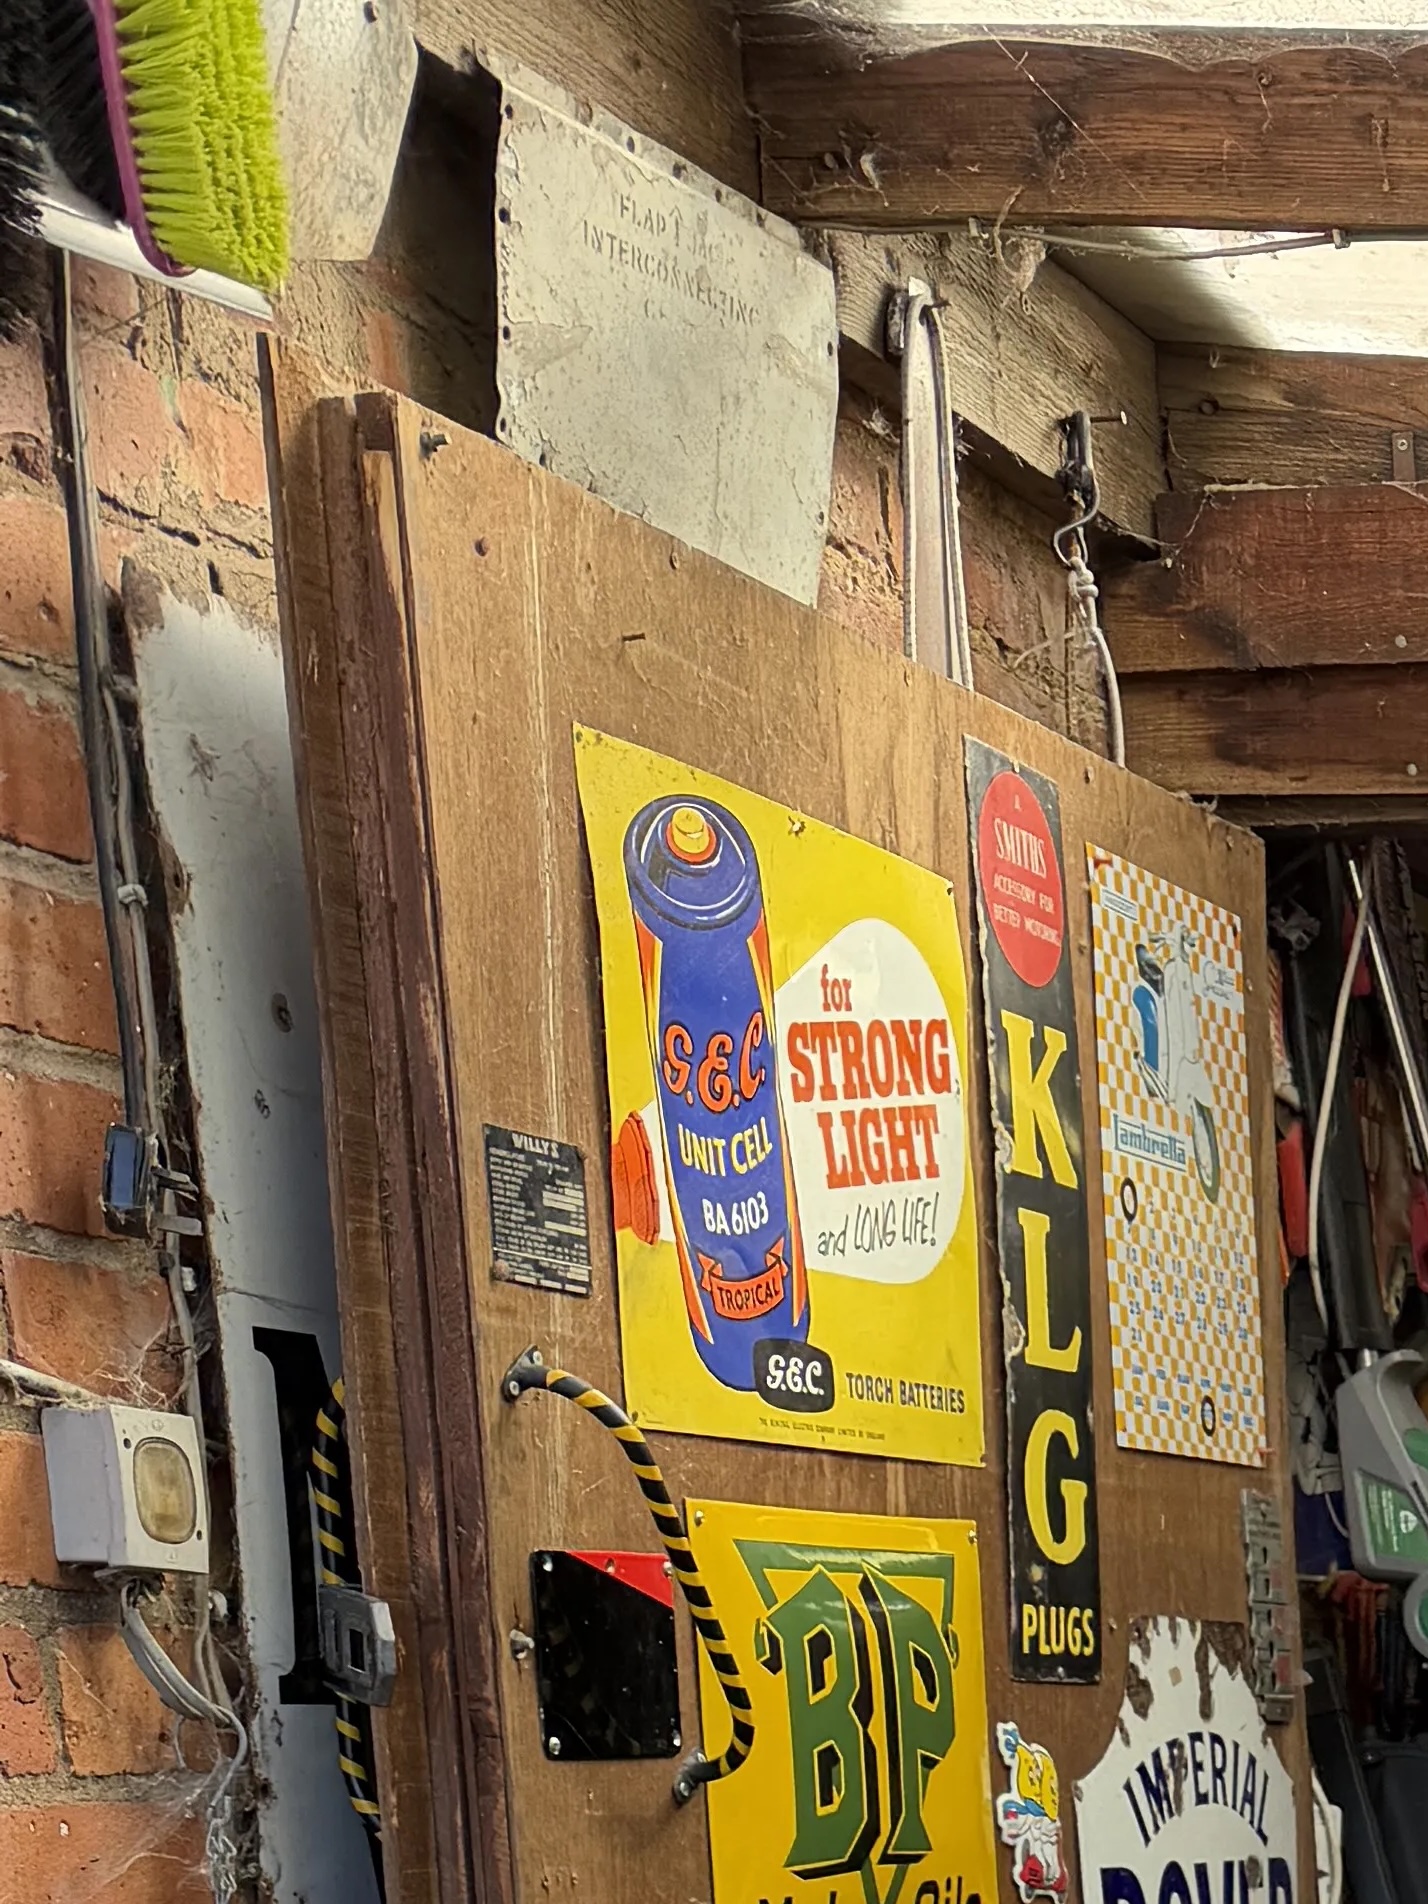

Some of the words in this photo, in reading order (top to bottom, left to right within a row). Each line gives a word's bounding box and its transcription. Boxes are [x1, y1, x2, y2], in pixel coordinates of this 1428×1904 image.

[620, 193, 666, 237] FLAP
[994, 818, 1047, 879] SMITHS
[820, 963, 852, 1012] for
[787, 1018, 952, 1102] STRONG
[678, 1123, 727, 1177] UNIT
[730, 1117, 773, 1175] CELL
[817, 1104, 940, 1189] LIGHT
[817, 1214, 850, 1256] and
[854, 1199, 897, 1253] LONG
[901, 1192, 940, 1247] LIFE!
[716, 1276, 780, 1312] TROPICAL
[845, 1372, 894, 1404] TORCH
[899, 1379, 965, 1413] BATTERIES
[1021, 1602, 1094, 1657] PLUGS
[765, 1559, 957, 1879] BP
